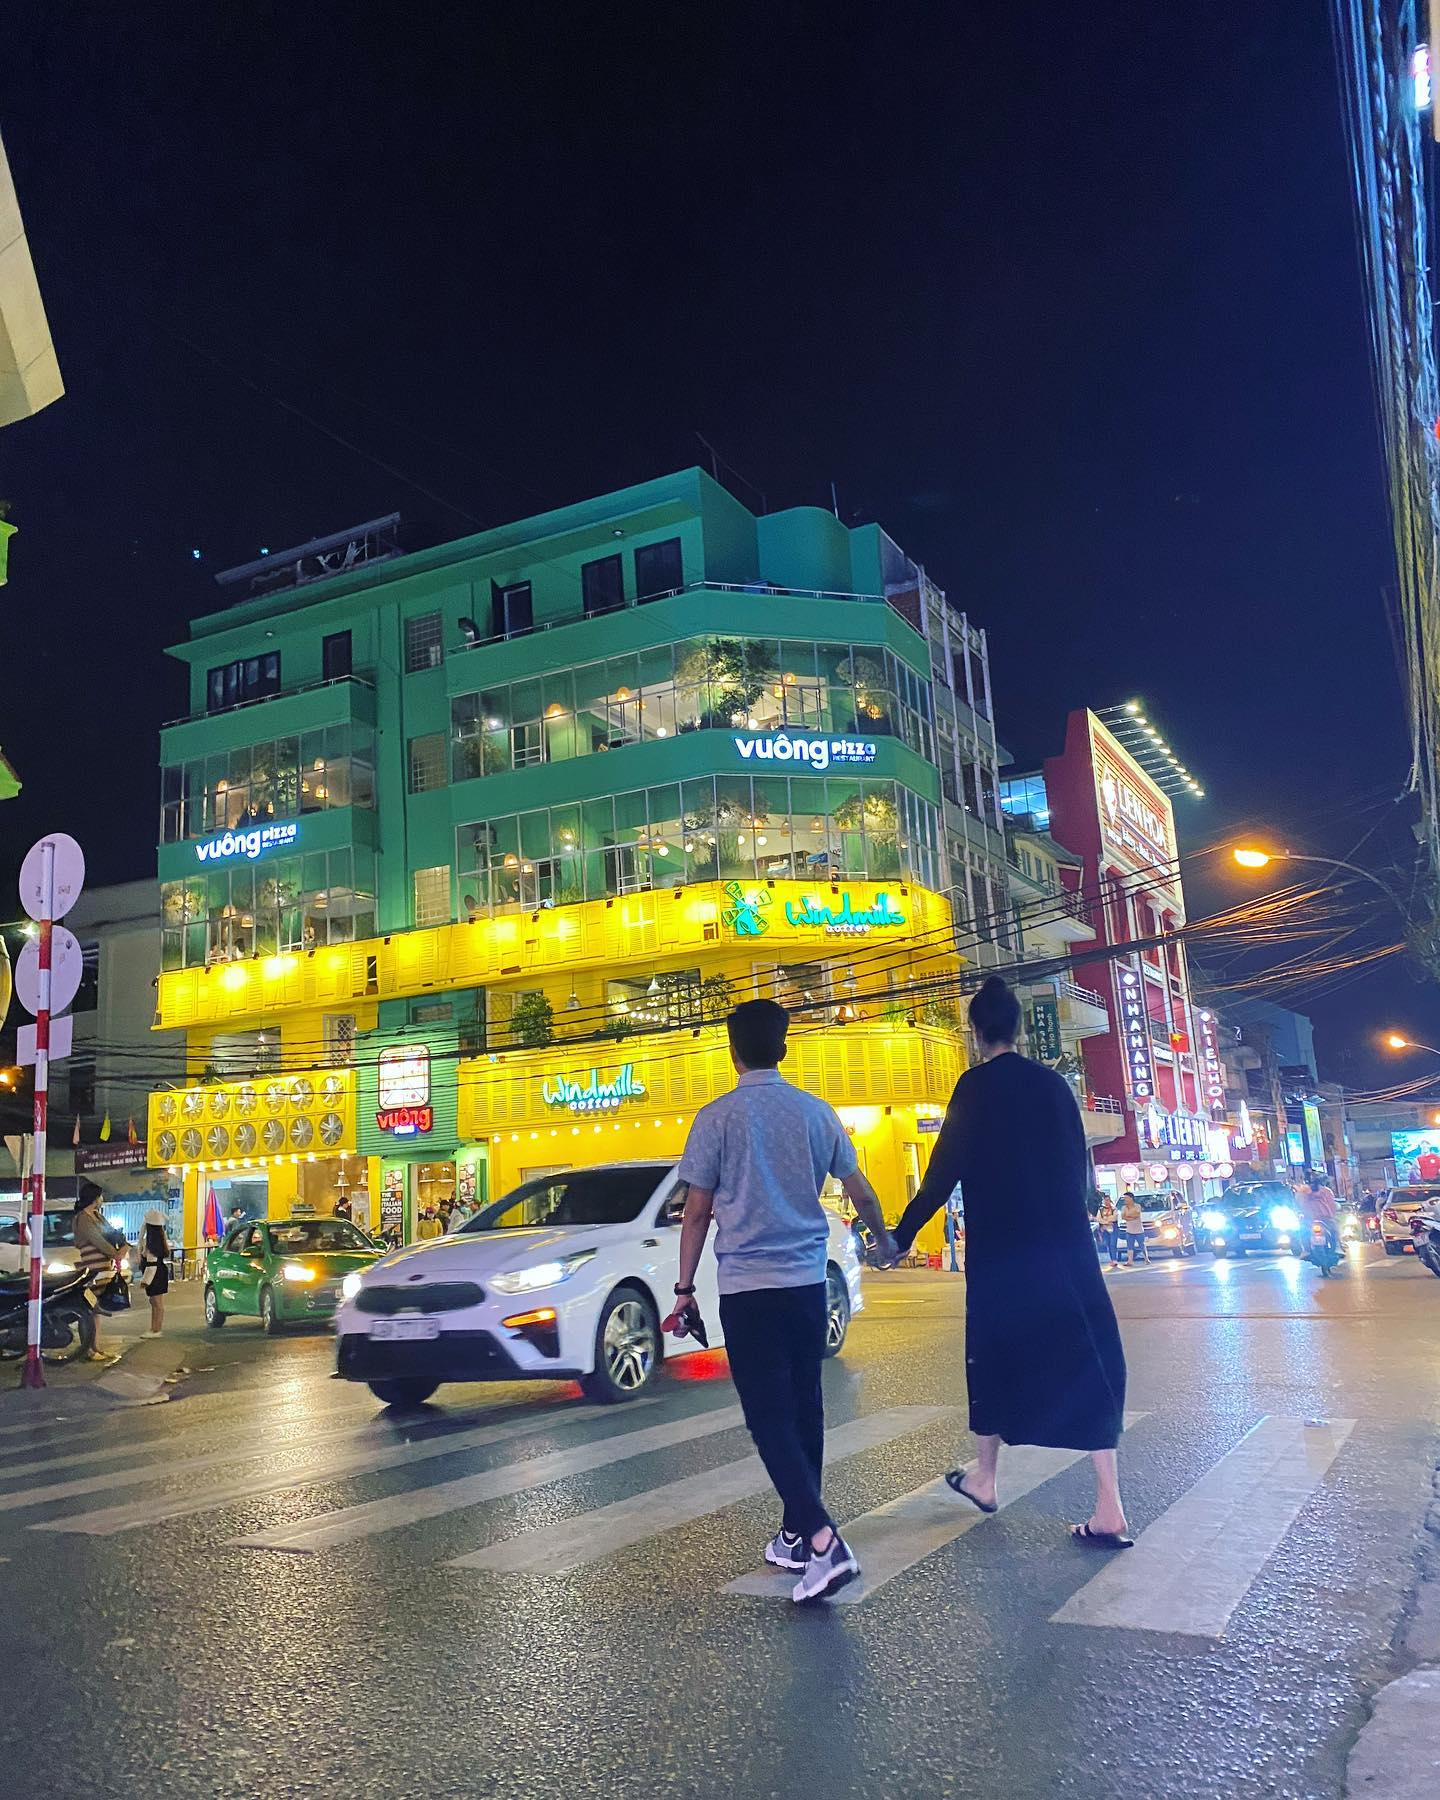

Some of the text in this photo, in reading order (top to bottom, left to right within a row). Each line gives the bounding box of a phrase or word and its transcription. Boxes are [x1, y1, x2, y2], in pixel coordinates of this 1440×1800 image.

[735, 733, 876, 770] vuông pizza
[195, 824, 297, 861] vuông pizza
[784, 891, 906, 926] Windmills
[542, 1063, 647, 1104] Windmills
[377, 1107, 431, 1131] vuông
[381, 1206, 402, 1214] FOOD
